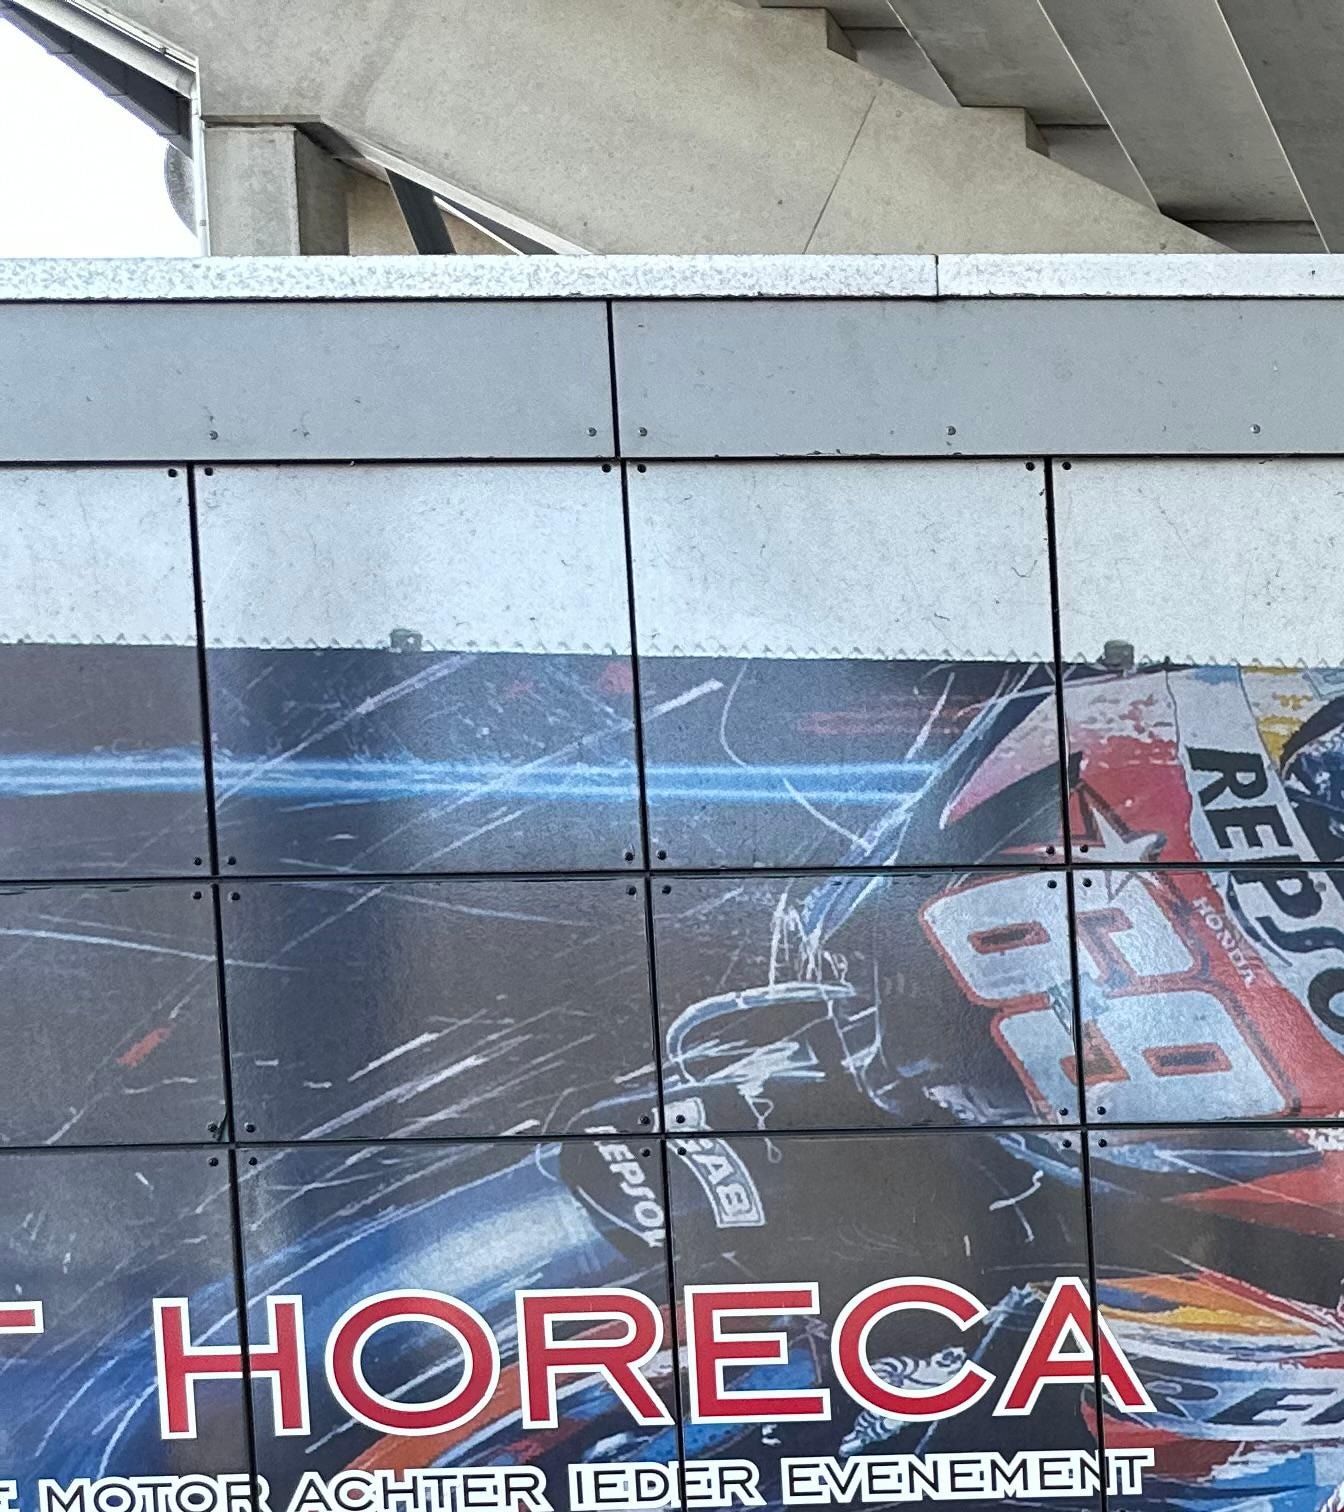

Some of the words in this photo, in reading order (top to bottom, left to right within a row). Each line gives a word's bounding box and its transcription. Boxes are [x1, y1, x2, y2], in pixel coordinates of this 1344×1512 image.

[153, 1276, 1157, 1440] HORECA
[568, 1458, 767, 1512] IEDER
[780, 1447, 1156, 1505] EVENEMENT
